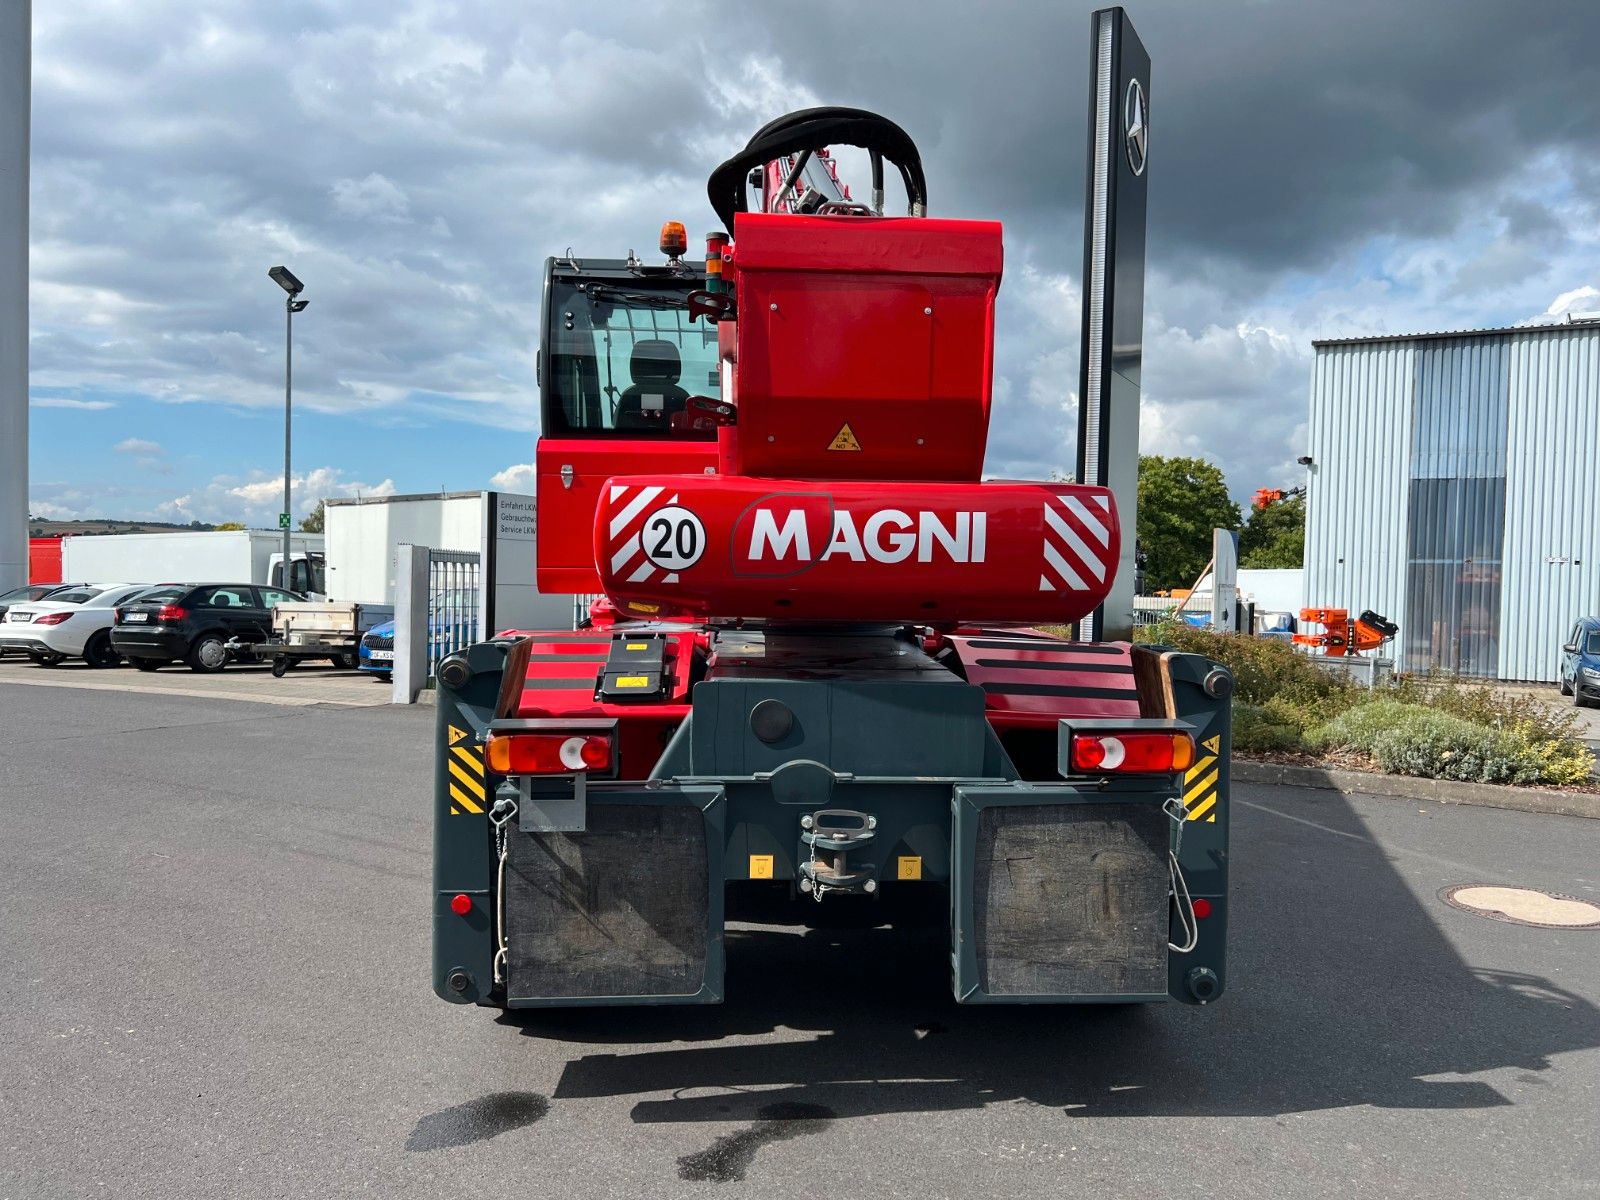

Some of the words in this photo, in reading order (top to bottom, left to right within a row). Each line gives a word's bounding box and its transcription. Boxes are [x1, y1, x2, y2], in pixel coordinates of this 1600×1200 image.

[500, 500, 523, 510] Einfahrt
[500, 524, 522, 534] Service
[523, 526, 536, 535] LKW
[650, 518, 697, 560] 20
[747, 508, 987, 563] MAGNI
